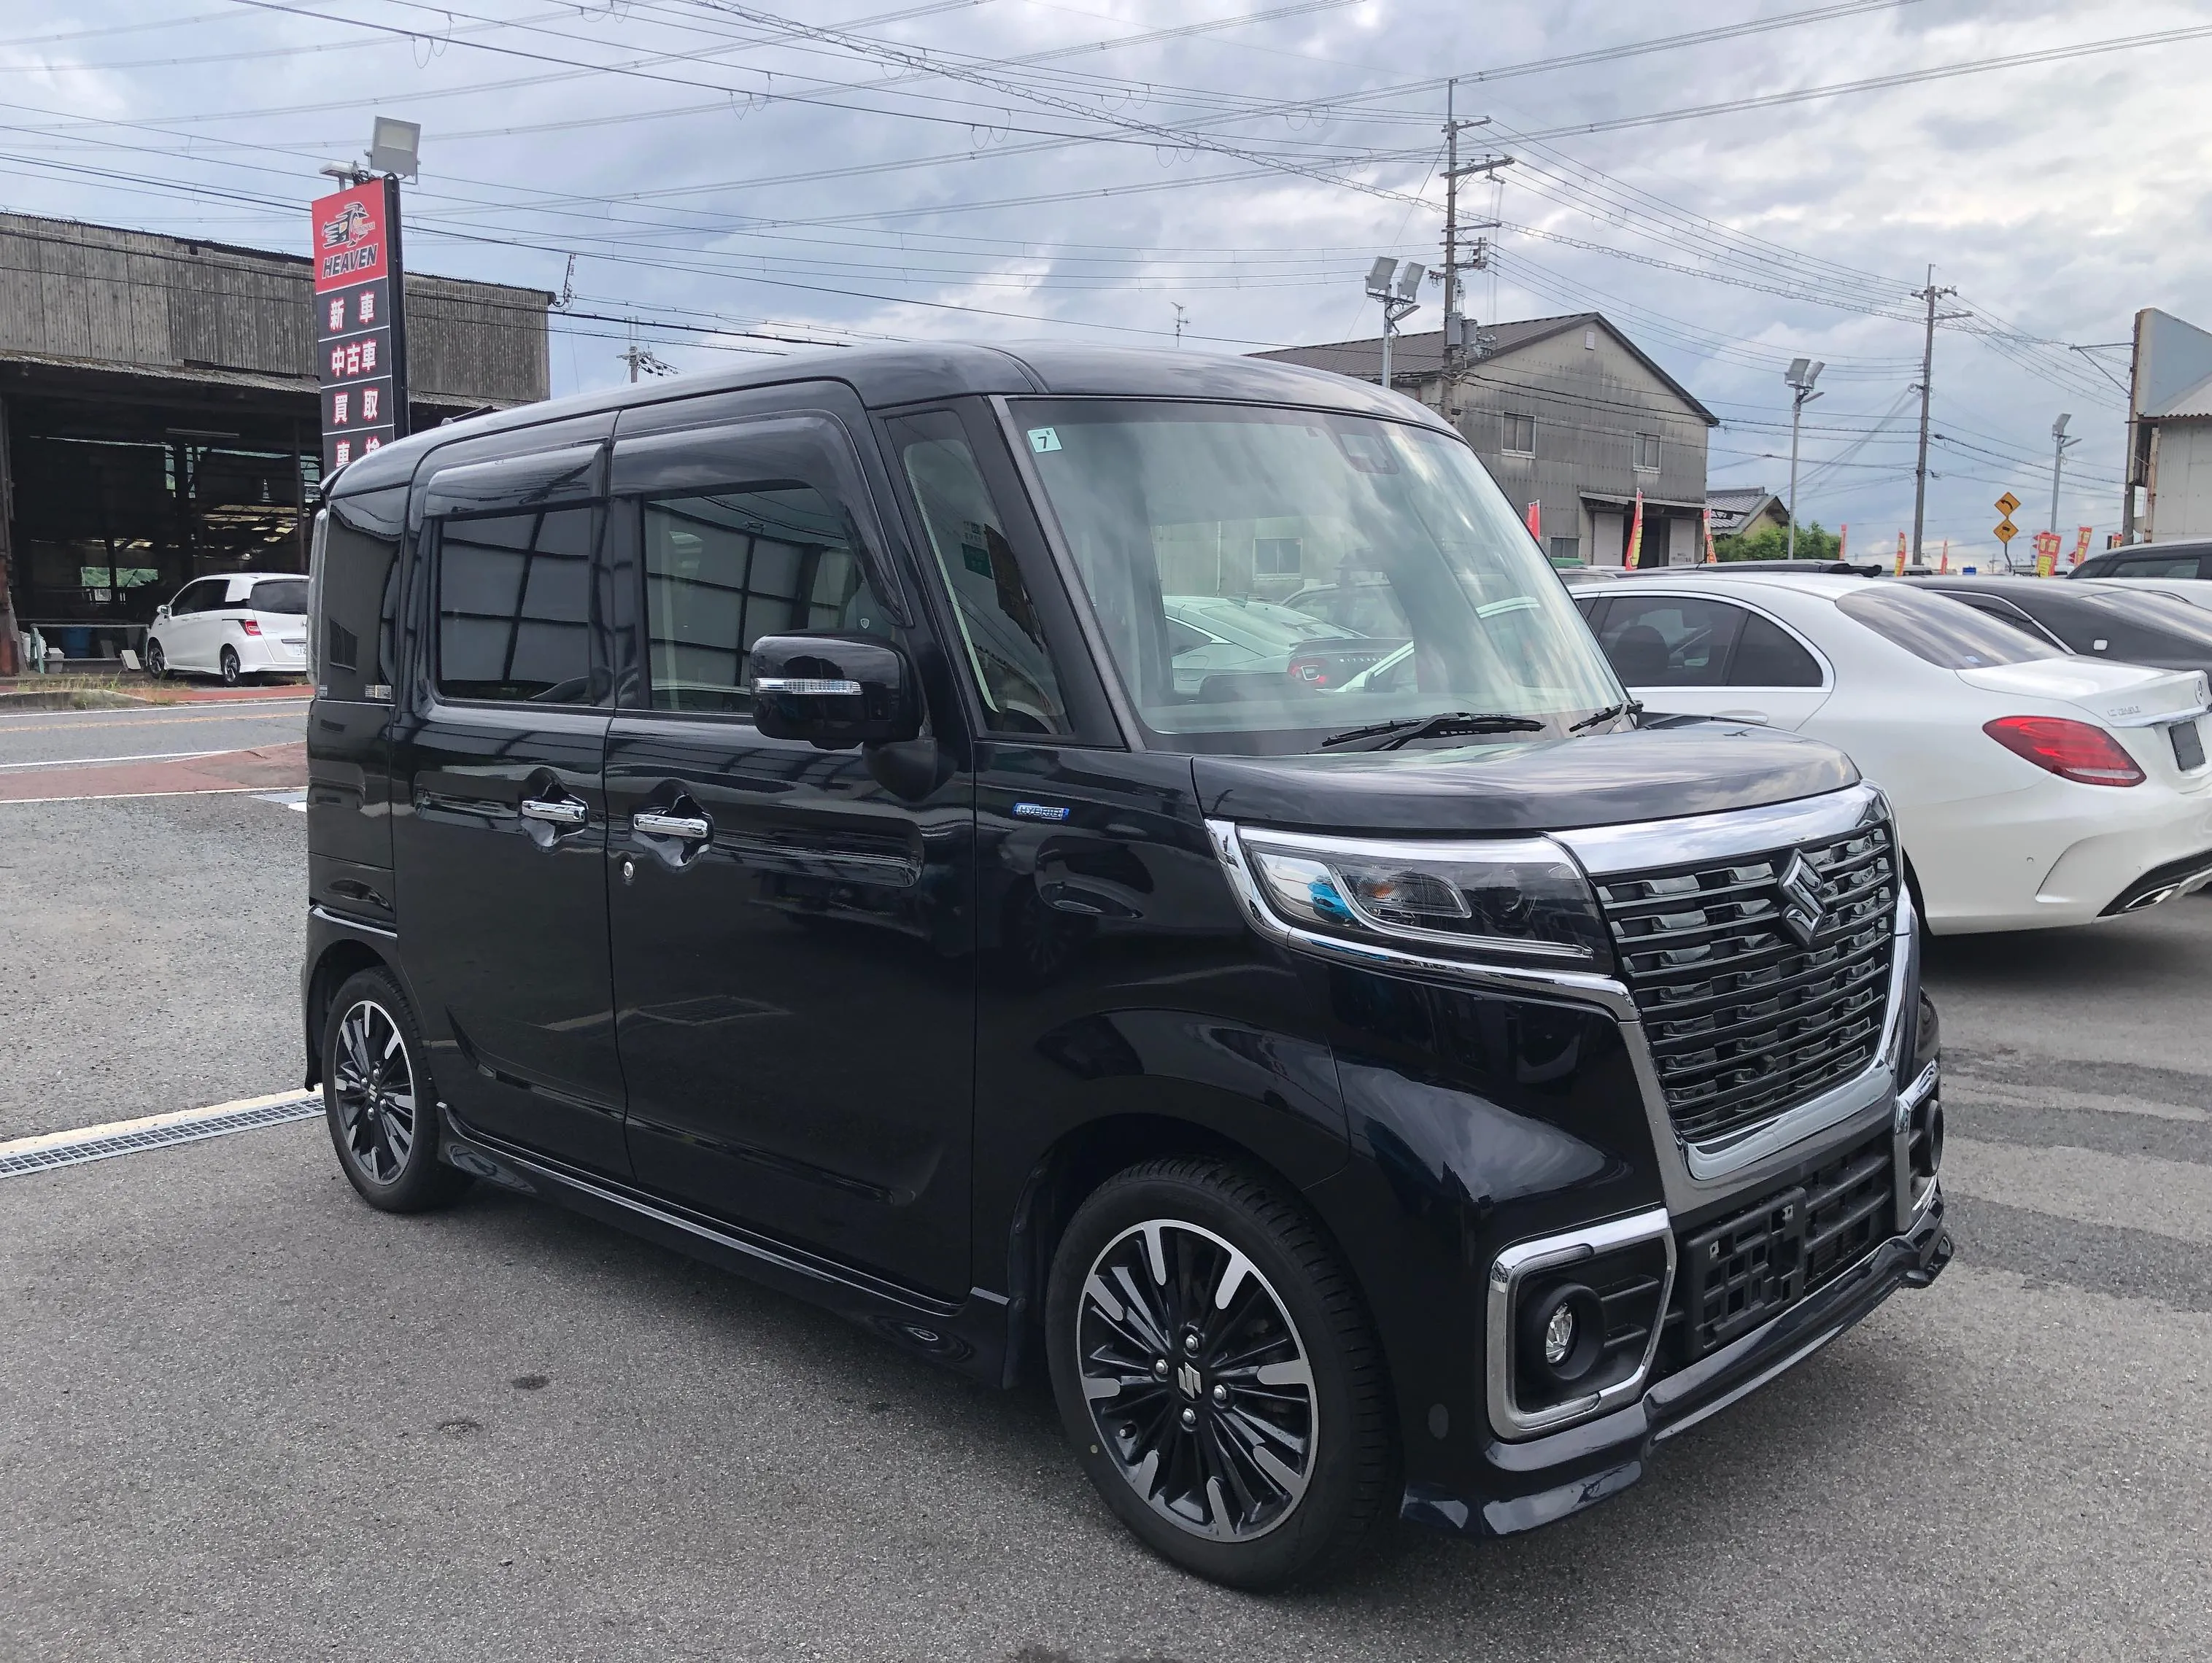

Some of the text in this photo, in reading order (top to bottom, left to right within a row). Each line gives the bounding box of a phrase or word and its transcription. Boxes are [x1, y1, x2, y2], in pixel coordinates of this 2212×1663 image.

[322, 243, 379, 279] HEAVEN
[330, 292, 374, 330] 新車
[331, 340, 377, 376] 中古車
[334, 389, 379, 424] 買取
[1037, 436, 1047, 449] 7
